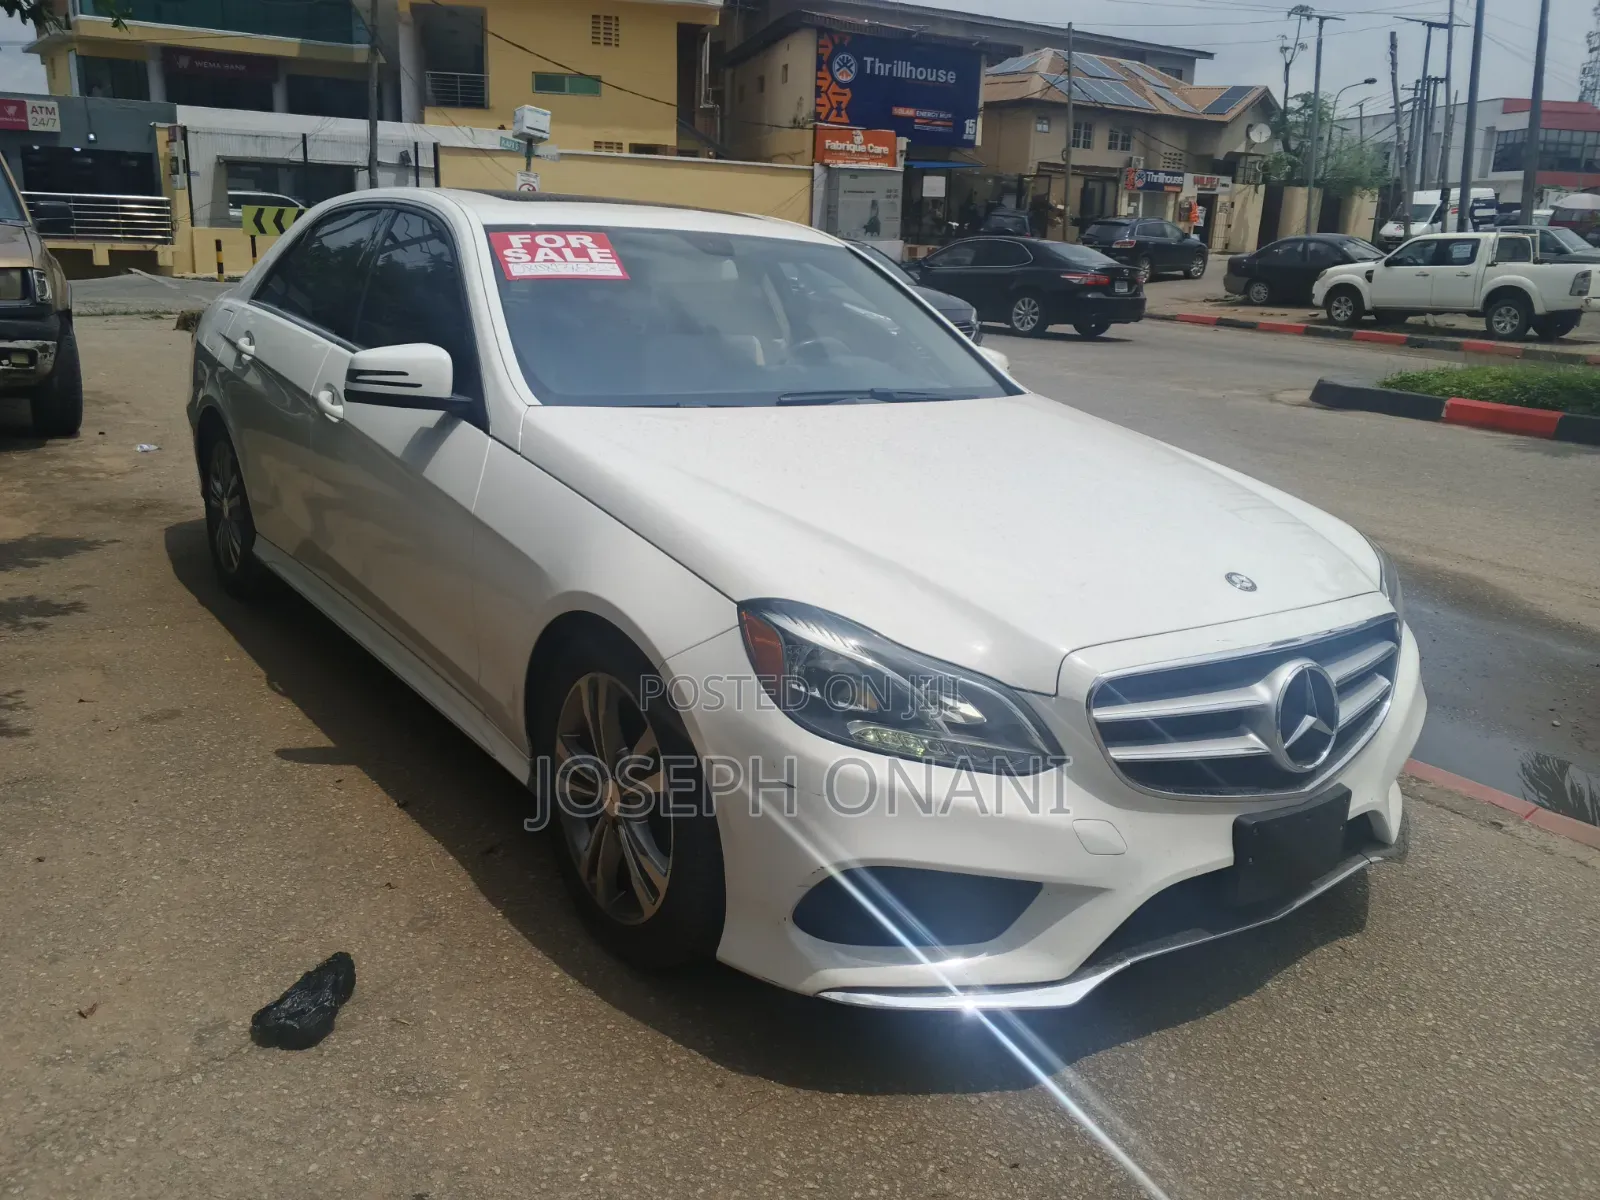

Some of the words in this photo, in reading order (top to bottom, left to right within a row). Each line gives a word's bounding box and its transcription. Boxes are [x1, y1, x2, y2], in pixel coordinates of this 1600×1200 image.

[194, 60, 221, 69] WEMA
[224, 63, 247, 72] BANK
[863, 56, 957, 84] Thrillhouse
[30, 105, 56, 116] ATM
[916, 110, 938, 118] ENERGY
[31, 116, 57, 128] 24/7
[964, 119, 976, 135] 15
[824, 139, 867, 153] Fabrique
[867, 143, 889, 154] Care
[1146, 171, 1184, 185] Thrillhouse
[507, 234, 600, 248] FOR
[503, 247, 617, 263] SALE
